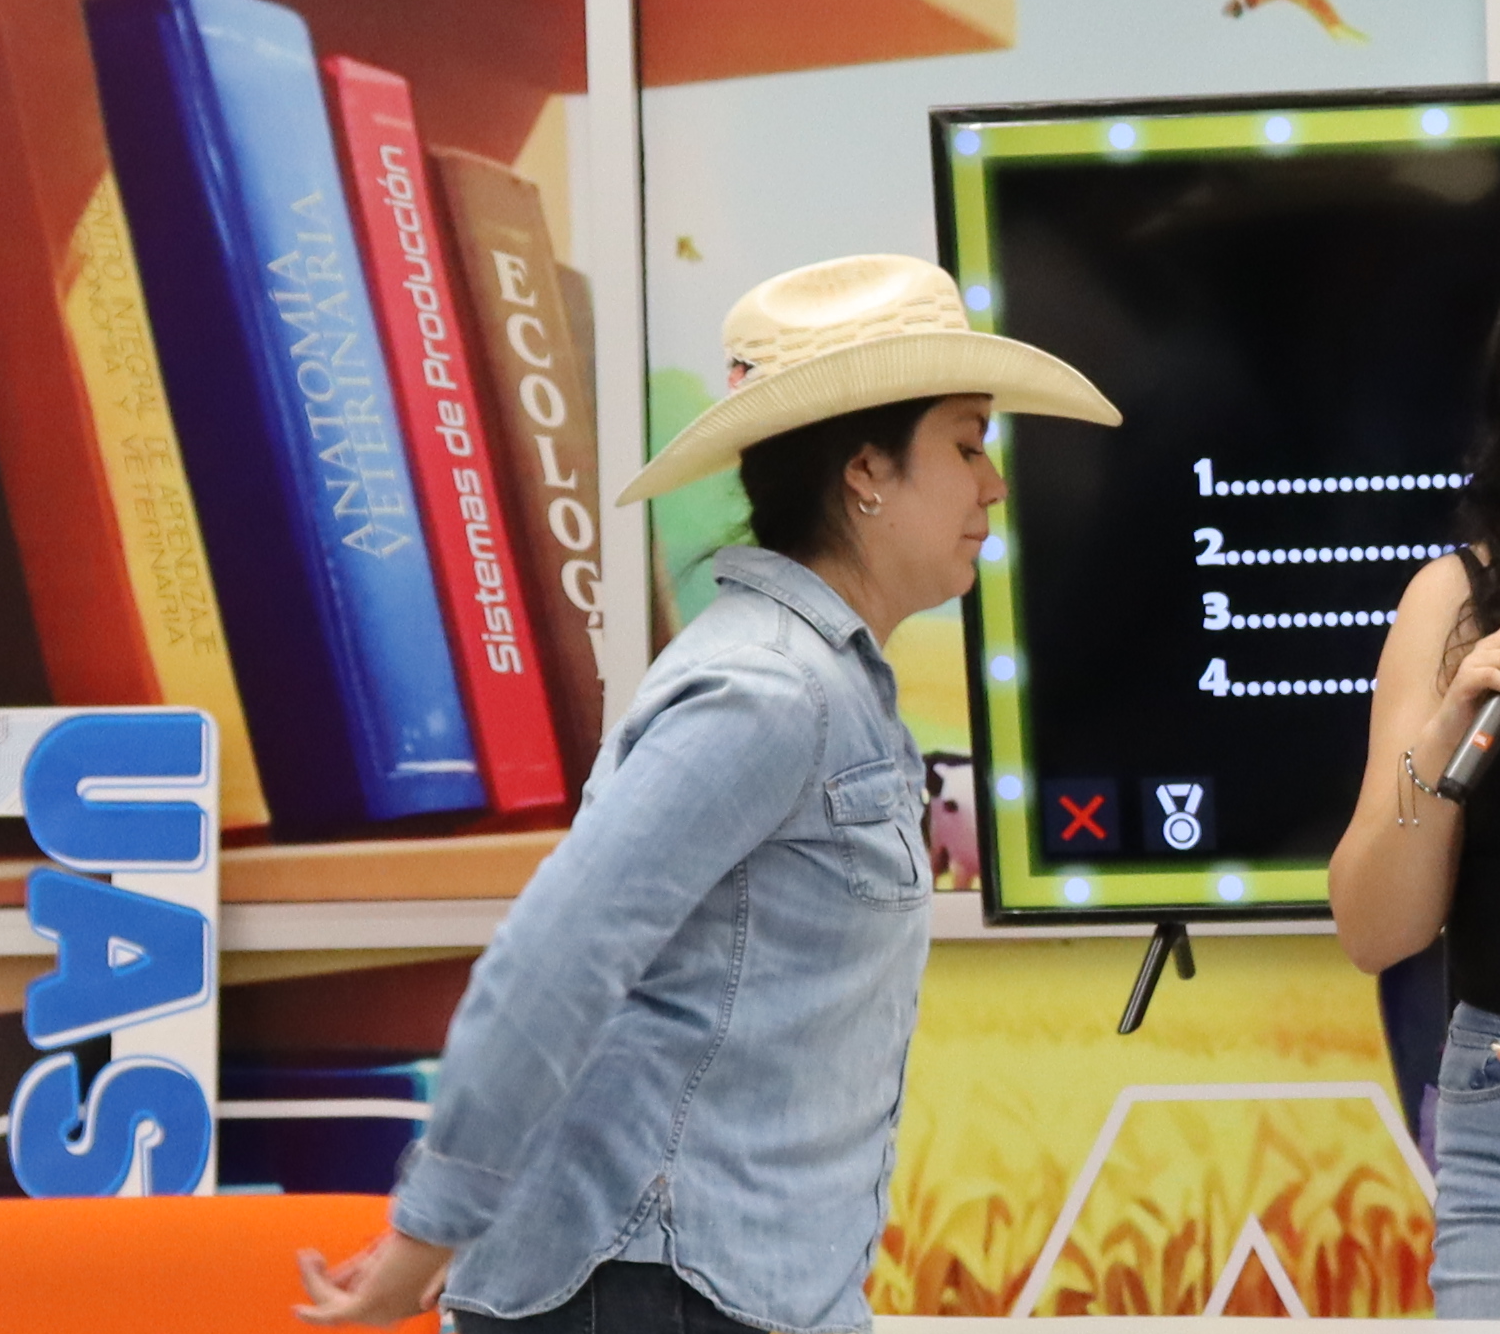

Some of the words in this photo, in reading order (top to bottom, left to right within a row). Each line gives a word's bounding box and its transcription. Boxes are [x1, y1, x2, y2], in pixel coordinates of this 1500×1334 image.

[289, 187, 414, 559] VETERINARIA
[376, 143, 458, 390] Producción
[434, 399, 473, 458] de
[451, 467, 524, 675] Sistemas
